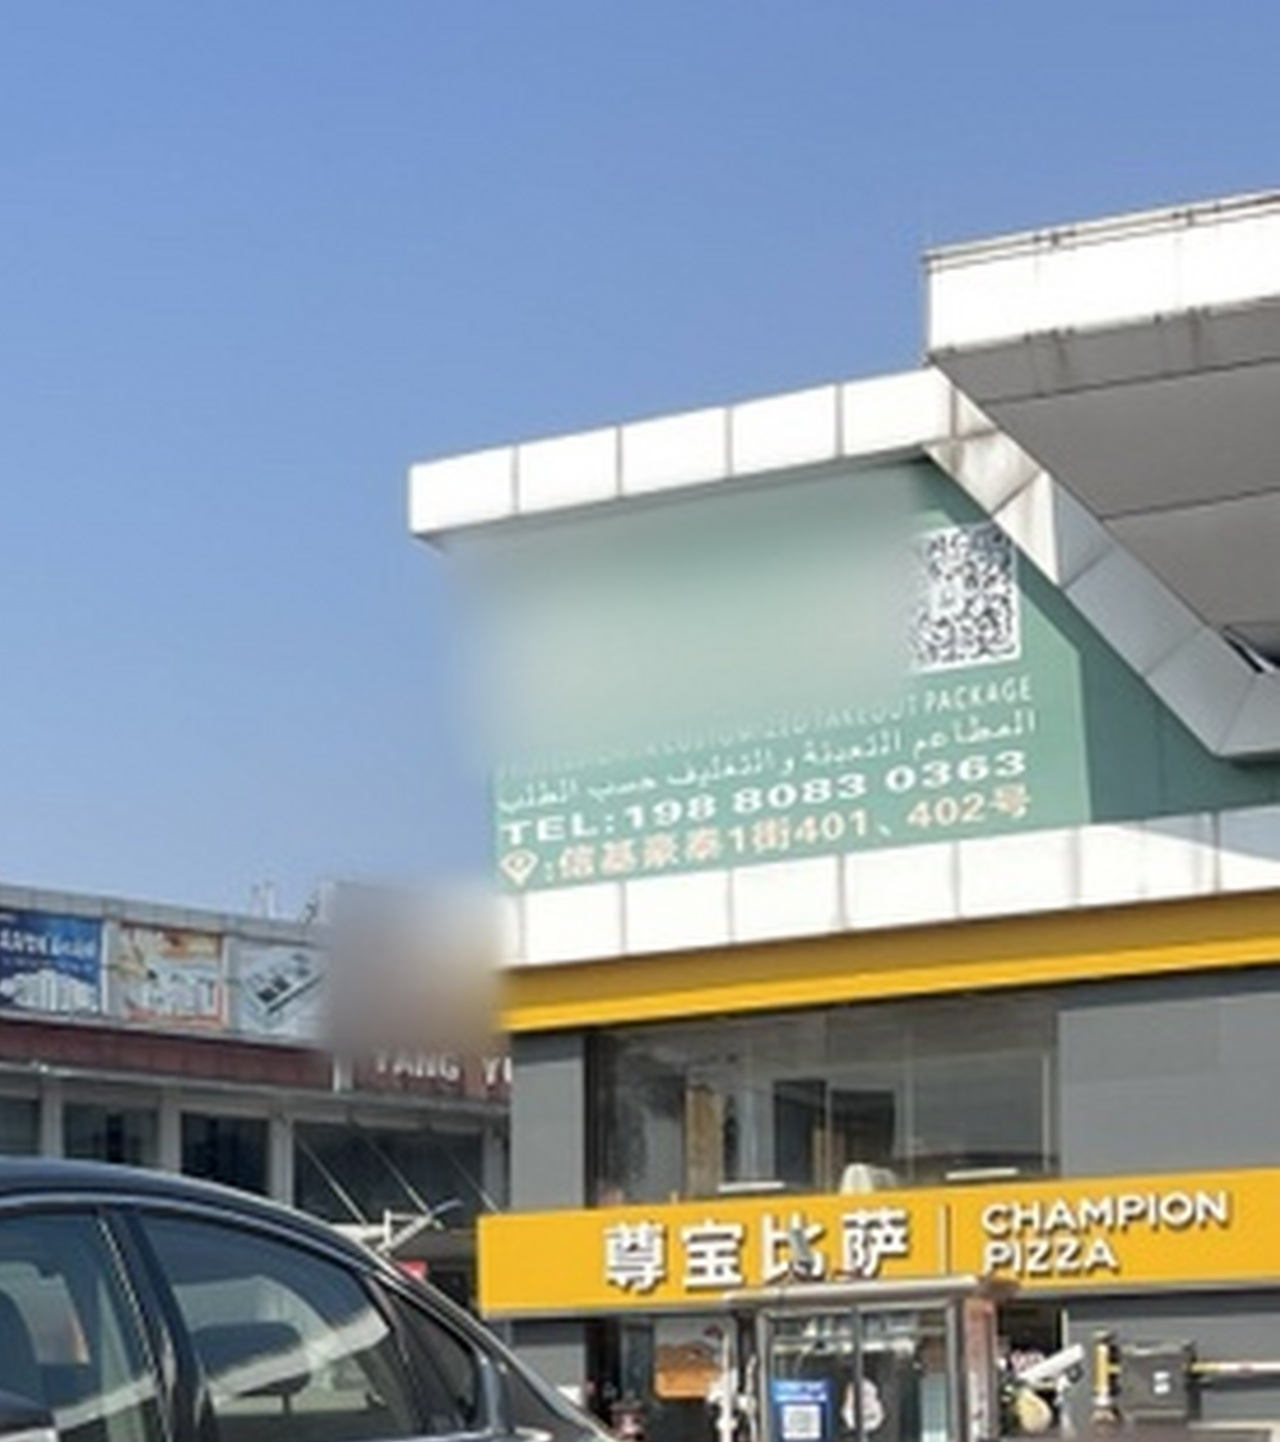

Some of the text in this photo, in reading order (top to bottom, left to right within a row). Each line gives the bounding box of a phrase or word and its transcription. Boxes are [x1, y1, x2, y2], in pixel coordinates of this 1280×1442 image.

[924, 674, 1032, 714] PACKAGE
[500, 749, 1027, 846] TEL:198 8083 0363
[981, 1191, 1228, 1236] CHAMPION
[603, 1208, 909, 1290] 尊宝比萨
[984, 1238, 1118, 1275] PIZZA
